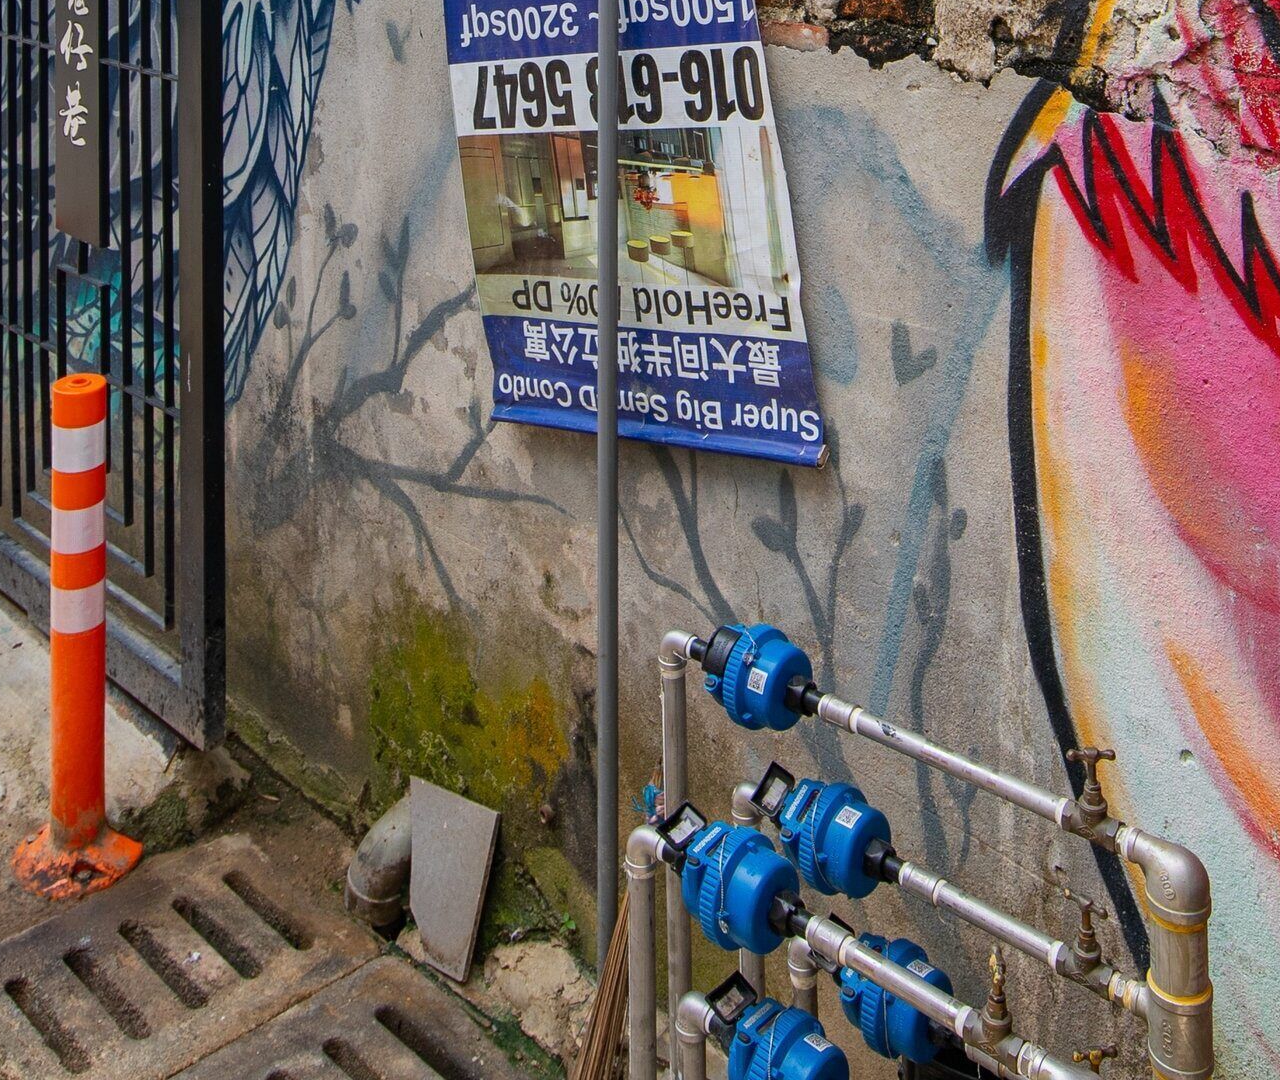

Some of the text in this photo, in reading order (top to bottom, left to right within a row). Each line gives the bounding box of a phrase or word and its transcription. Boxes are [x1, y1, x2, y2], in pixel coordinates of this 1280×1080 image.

[460, 2, 580, 48] 3200sqf
[472, 59, 576, 131] 5647
[511, 279, 553, 313] DP
[632, 287, 793, 332] FreeHold
[498, 373, 820, 442] Super Big SemD Condo
